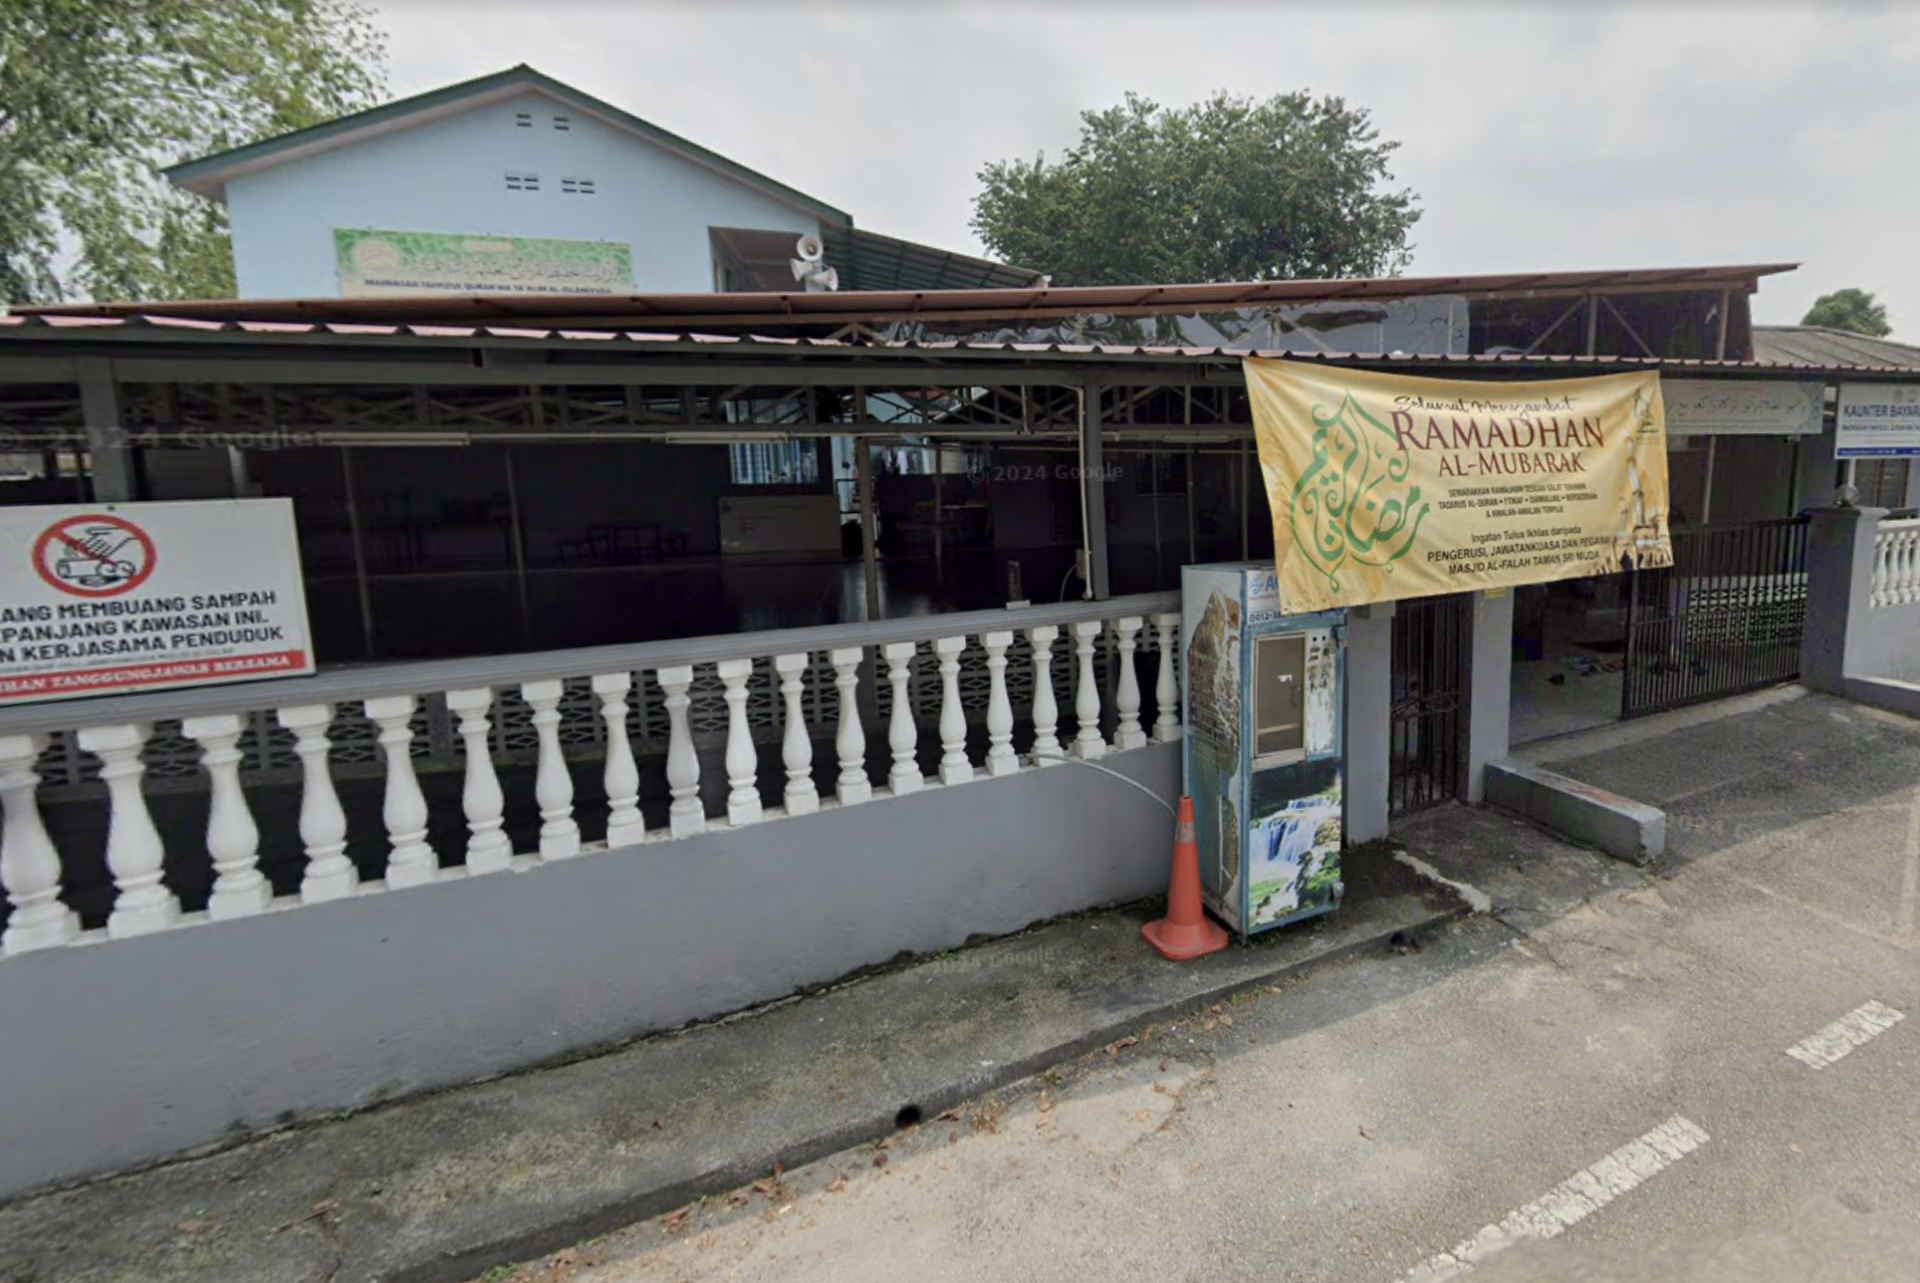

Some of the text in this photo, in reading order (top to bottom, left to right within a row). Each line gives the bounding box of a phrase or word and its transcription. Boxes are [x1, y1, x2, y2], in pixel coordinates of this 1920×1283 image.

[1843, 404, 1888, 417] KAUNTER
[1388, 411, 1604, 451] RAMADHAN
[1437, 451, 1586, 477] AL-MUBARAK
[1471, 533, 1502, 544] Ingatan
[1503, 530, 1525, 540] Tulus
[1550, 525, 1582, 537] daripada
[1490, 540, 1560, 557] JAWATANKUASA
[1561, 538, 1578, 548] DAN
[1449, 550, 1599, 575] MASJID AL-FALAH TAMAN SRI MUDA
[58, 596, 186, 620] MEMBUANG
[191, 590, 276, 611] SAMPAH
[122, 611, 230, 634] KAWASAN
[234, 610, 270, 626] INI.
[22, 635, 166, 661] KERJASAMA
[171, 626, 284, 650] PENDUDUK
